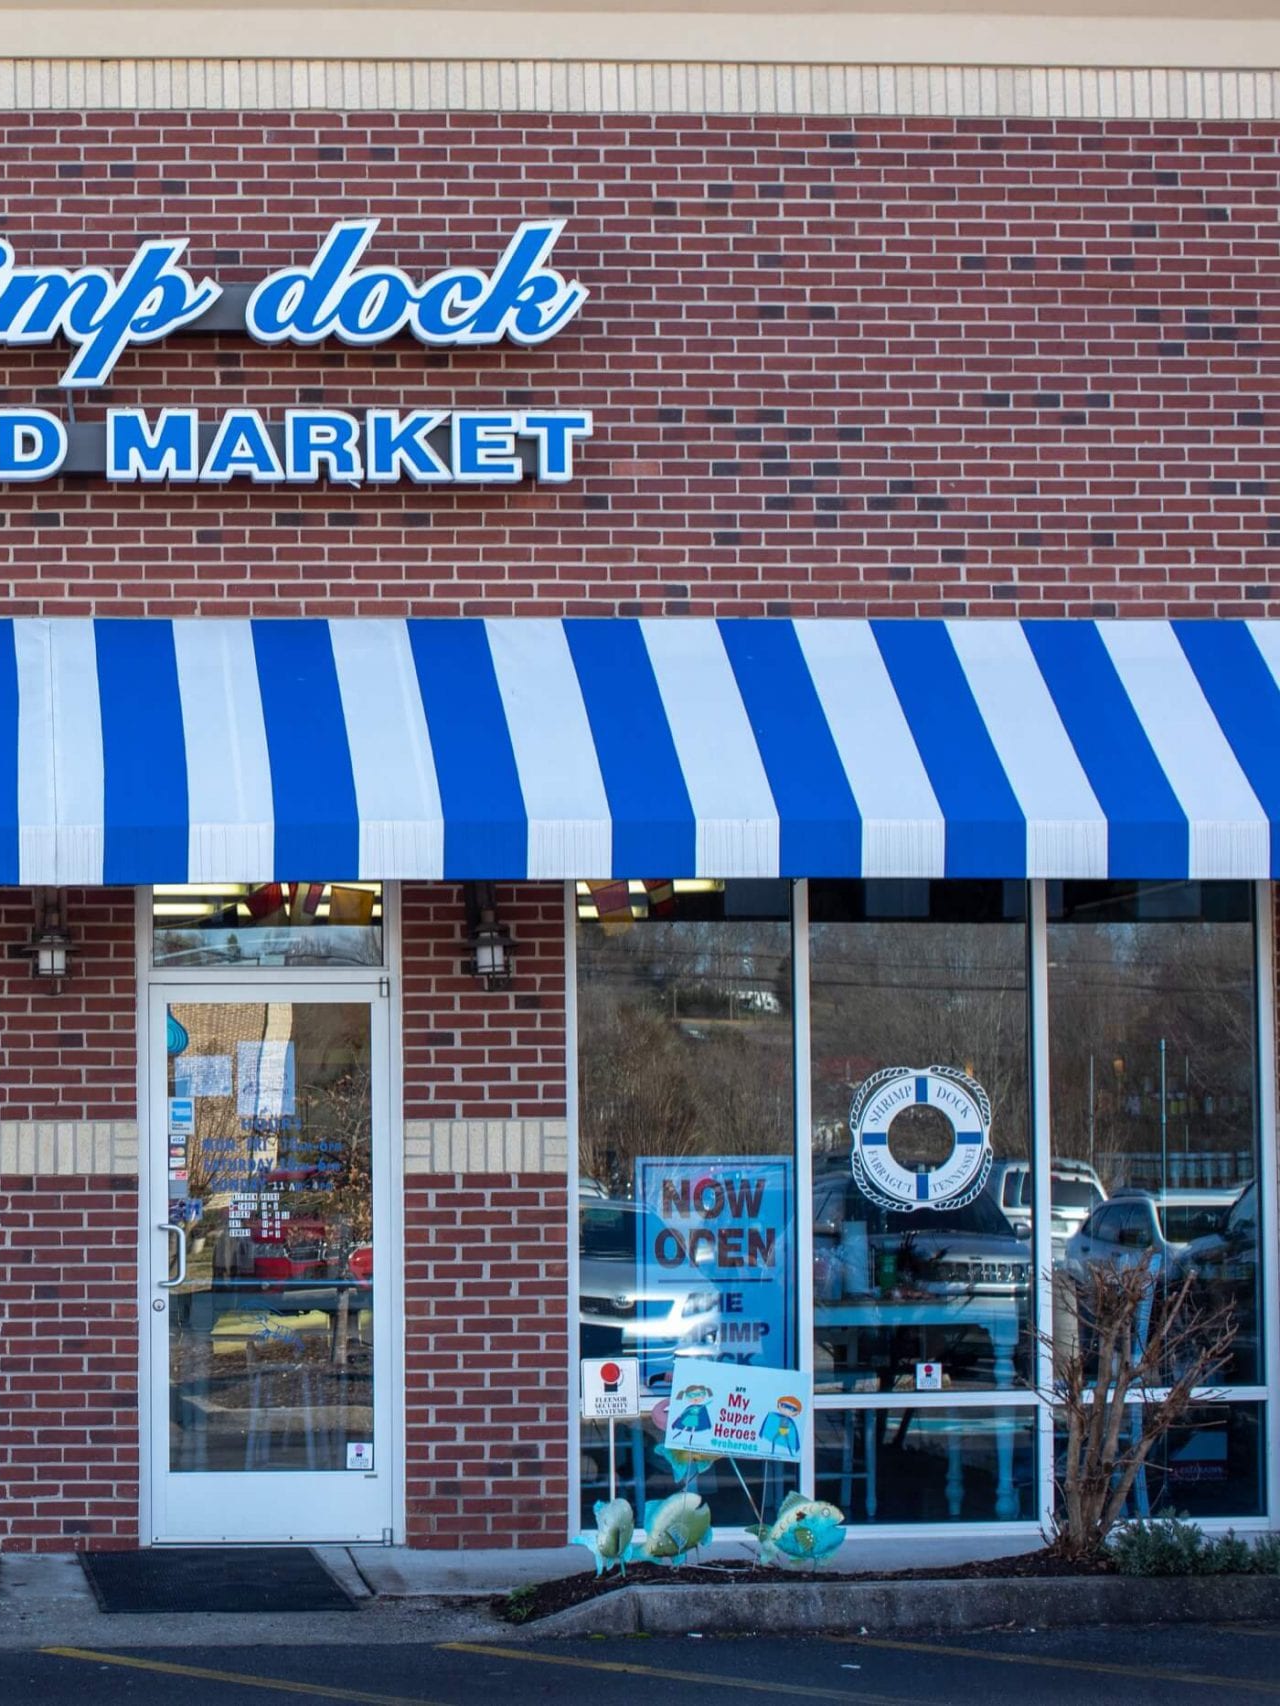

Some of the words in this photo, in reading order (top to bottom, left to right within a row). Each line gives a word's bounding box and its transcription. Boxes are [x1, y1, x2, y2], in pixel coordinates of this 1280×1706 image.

[244, 217, 590, 347] dock
[105, 409, 592, 484] MARKET
[869, 1085, 912, 1125] SHRIMP
[936, 1086, 972, 1118] DOCK
[868, 1150, 913, 1193] FARRAGUT
[929, 1147, 977, 1193] TENNESSEE
[662, 1178, 765, 1219] NOW
[655, 1228, 775, 1269] OPEN
[719, 1408, 756, 1426] Super
[728, 1393, 750, 1410] My
[714, 1423, 757, 1441] Heroes
